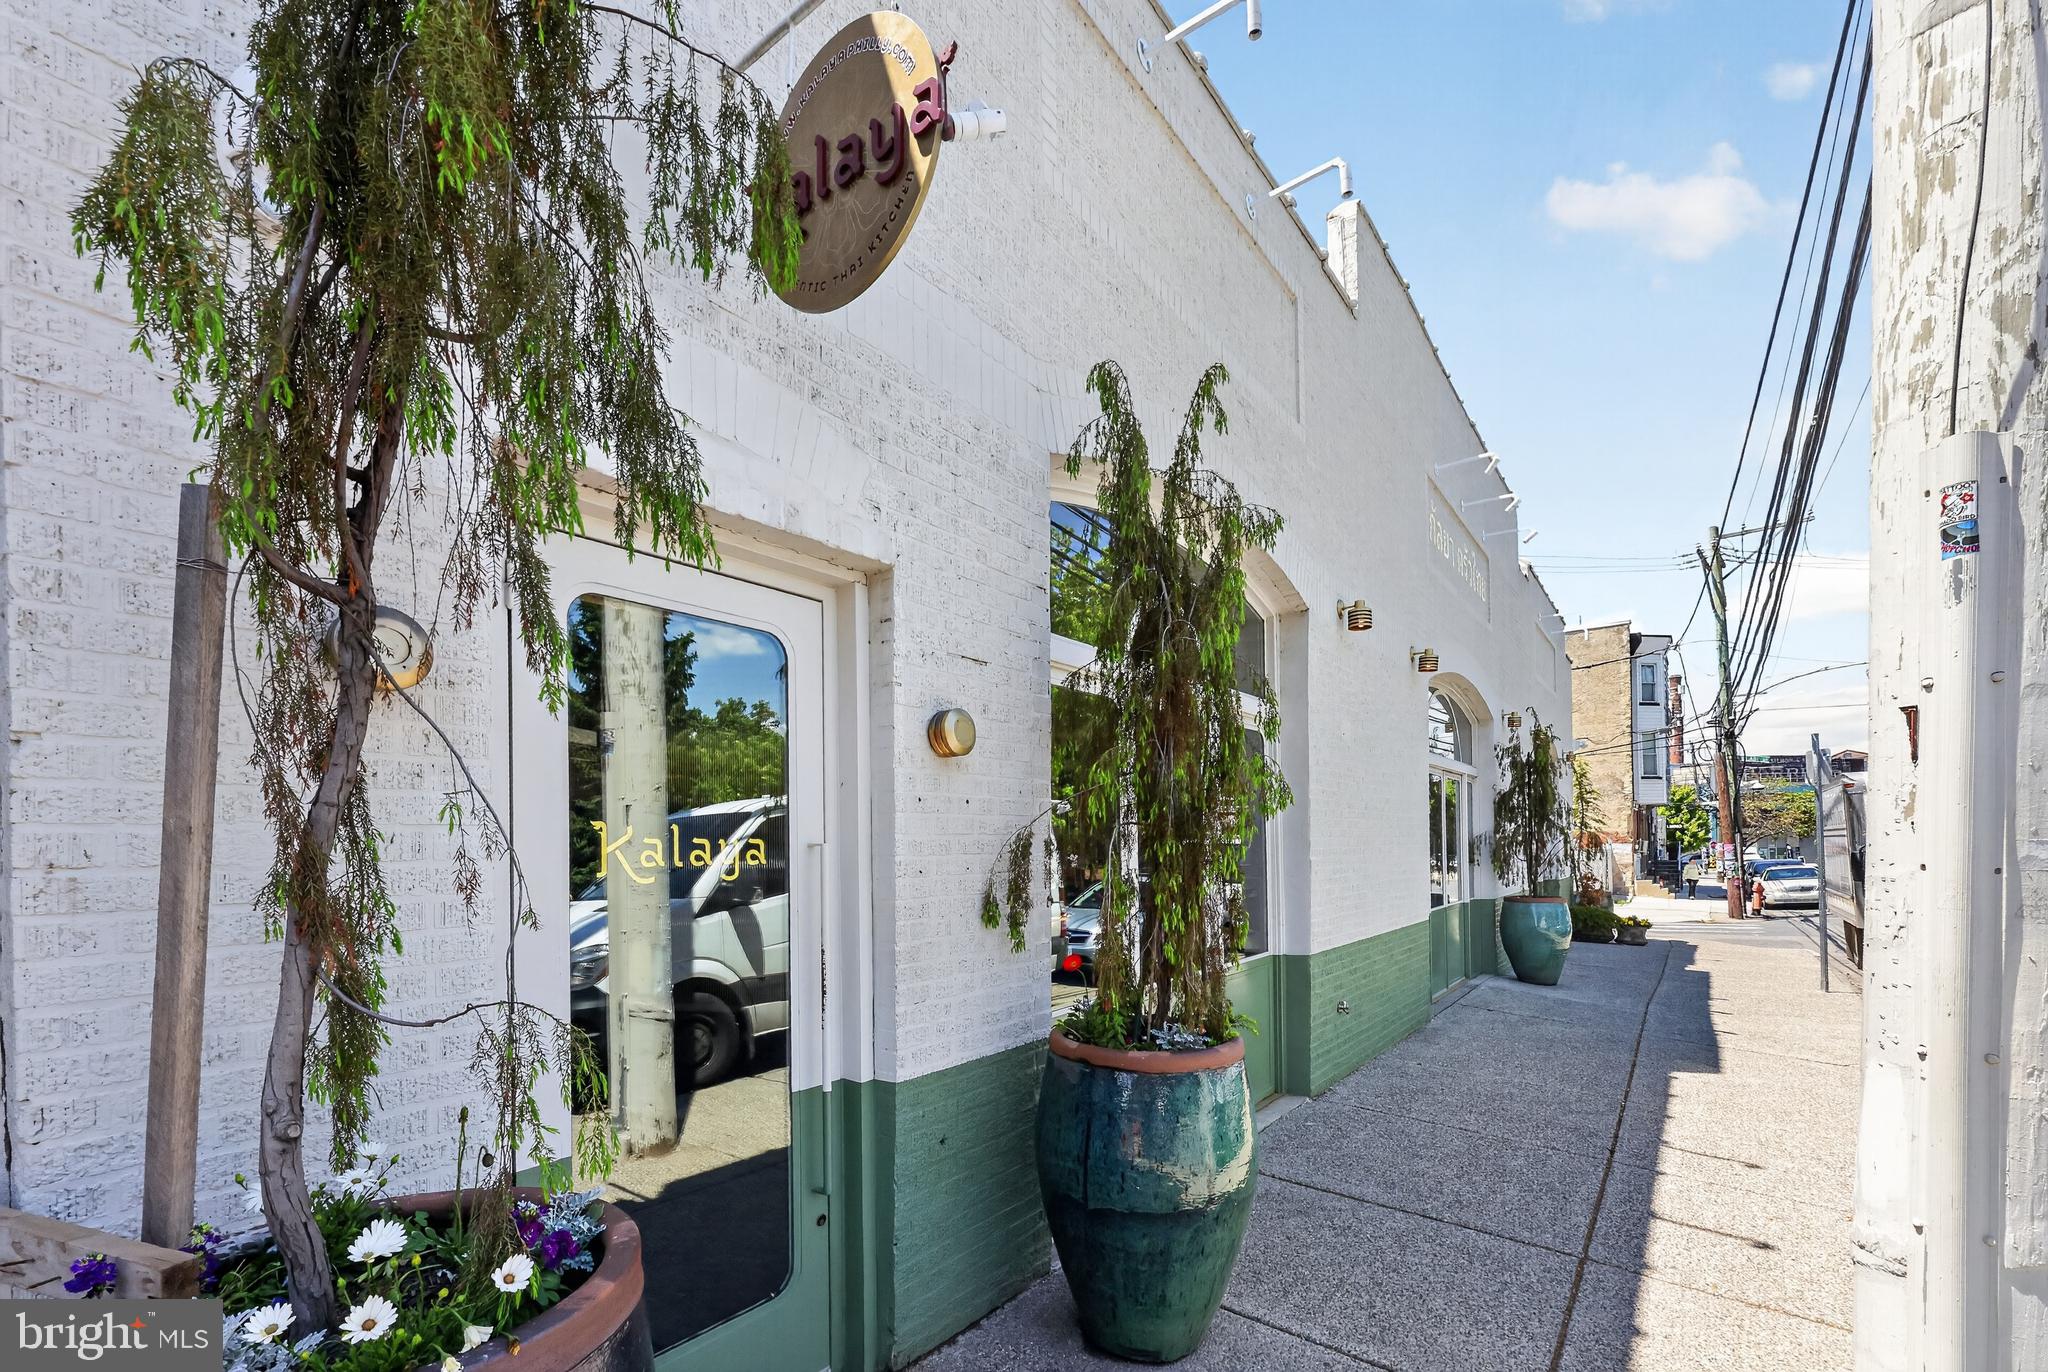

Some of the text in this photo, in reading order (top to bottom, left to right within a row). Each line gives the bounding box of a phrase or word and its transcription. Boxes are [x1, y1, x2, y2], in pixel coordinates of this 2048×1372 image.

[747, 77, 946, 240] alaya
[833, 256, 864, 287] THAI
[868, 170, 915, 254] KITCHEN
[590, 820, 767, 884] Kalaya
